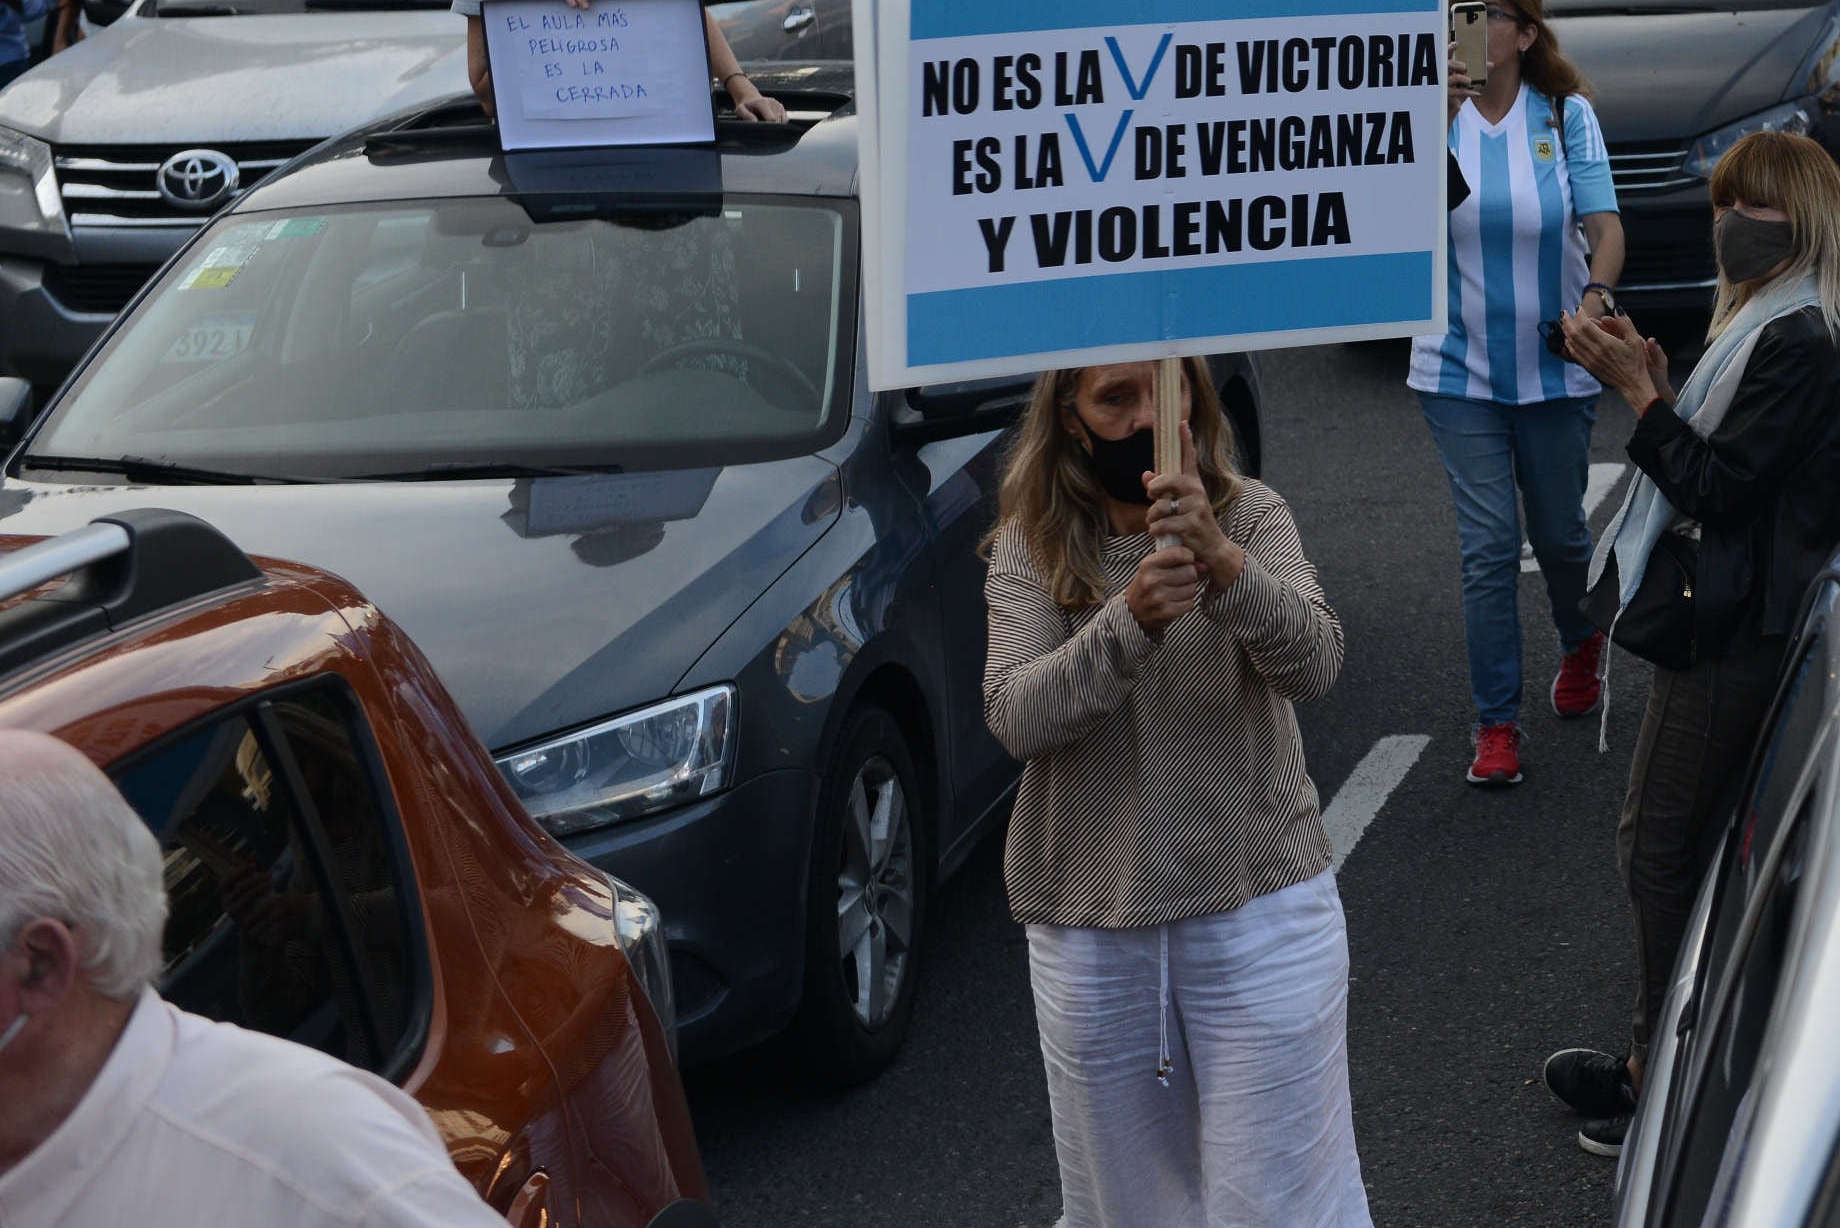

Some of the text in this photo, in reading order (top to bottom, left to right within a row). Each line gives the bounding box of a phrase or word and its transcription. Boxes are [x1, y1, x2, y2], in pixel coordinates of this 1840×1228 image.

[506, 15, 530, 33] EL
[542, 14, 586, 30] AULA
[528, 37, 620, 55] PELIGROSA
[544, 60, 605, 77] ES LA
[922, 33, 1439, 117] NO ES LA V DE VICTORIA
[556, 84, 648, 103] CERRADA
[952, 109, 1415, 196] ES LA V DE VENGANZA
[978, 191, 1352, 274] Y VIOLENCIA
